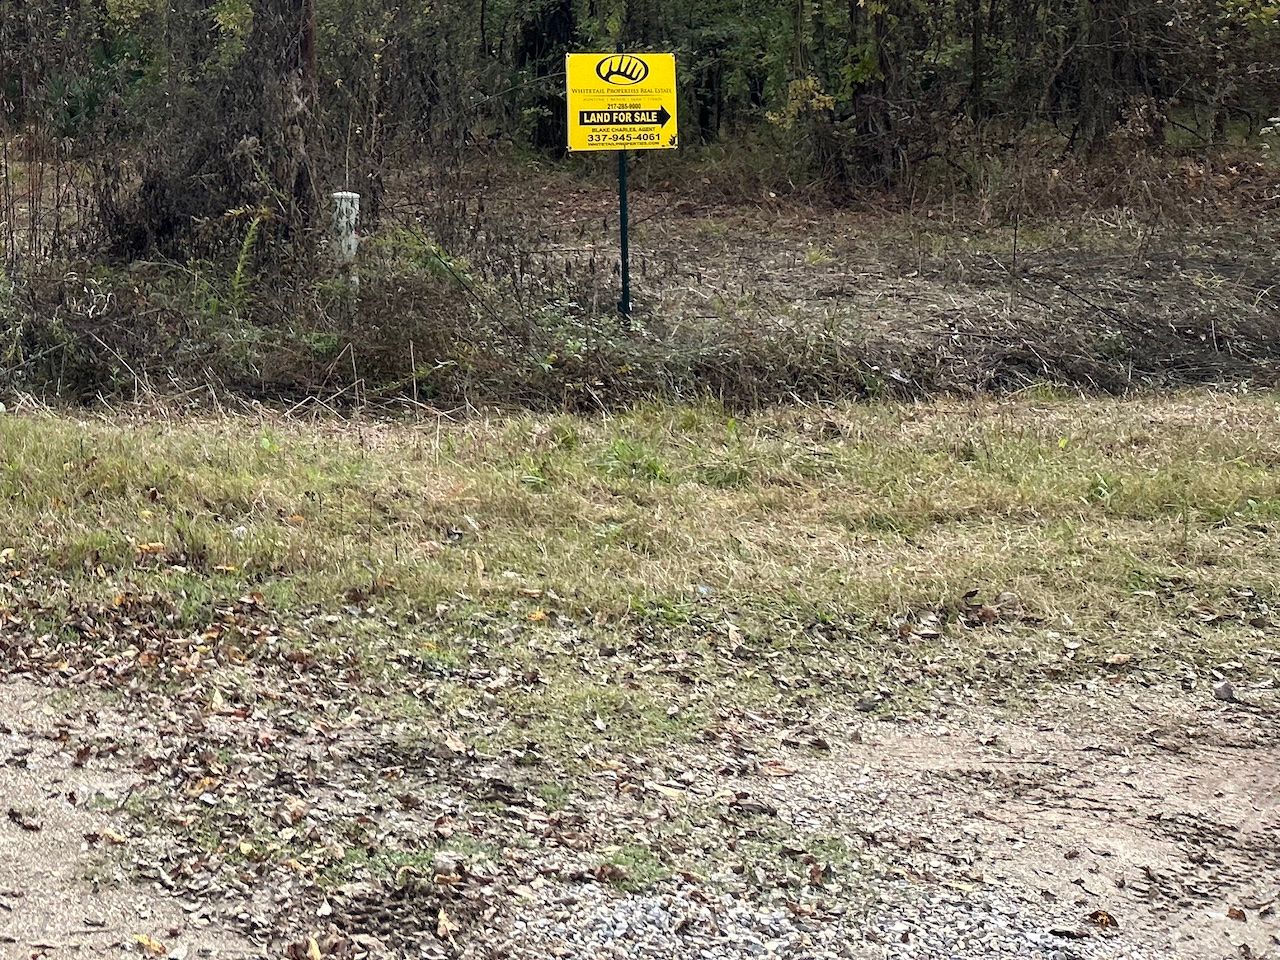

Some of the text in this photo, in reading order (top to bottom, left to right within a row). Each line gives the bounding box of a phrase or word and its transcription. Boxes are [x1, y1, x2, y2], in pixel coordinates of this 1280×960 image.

[583, 112, 658, 123] LAND FOR SALE
[587, 133, 661, 142] 337-945-4061
